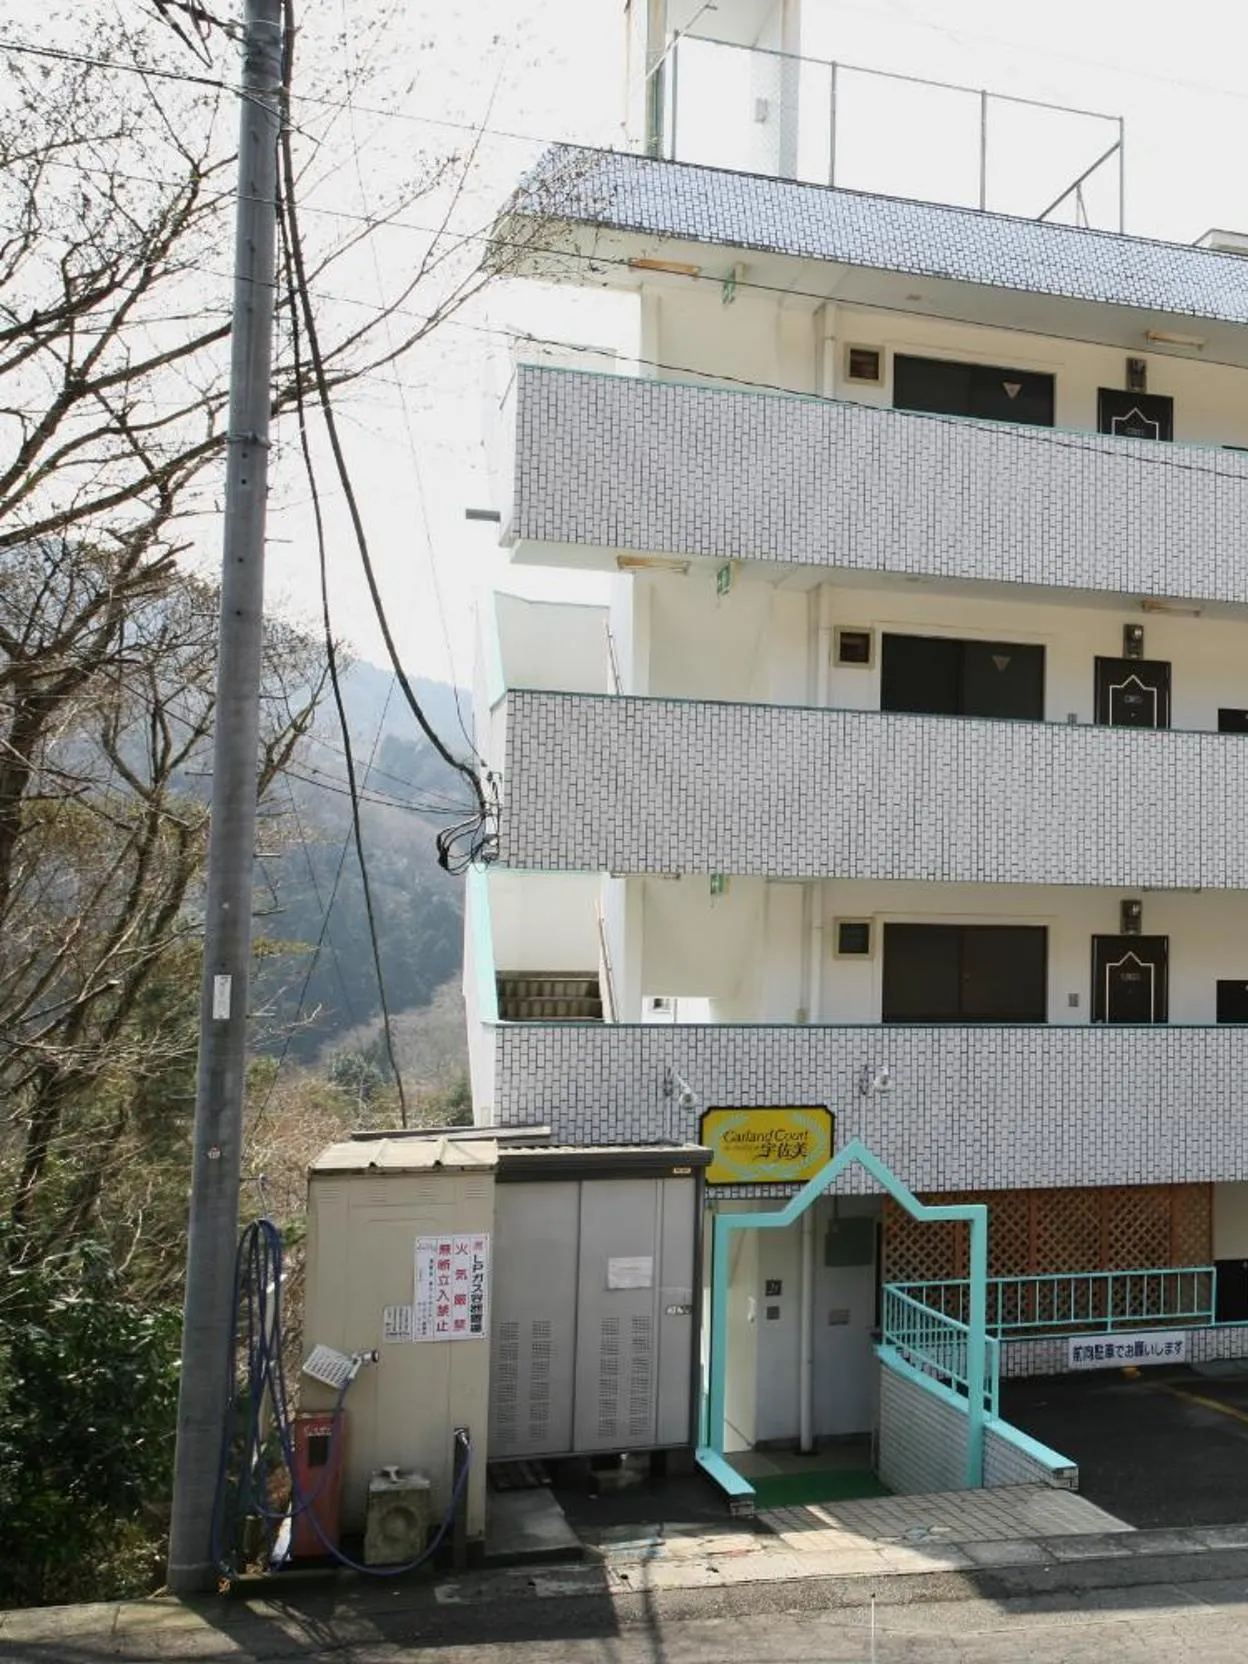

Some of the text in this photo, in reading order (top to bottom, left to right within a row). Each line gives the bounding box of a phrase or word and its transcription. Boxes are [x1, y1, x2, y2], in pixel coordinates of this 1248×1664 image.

[436, 1244, 451, 1332] 無断立入禁止
[454, 1243, 468, 1330] 火気厳禁
